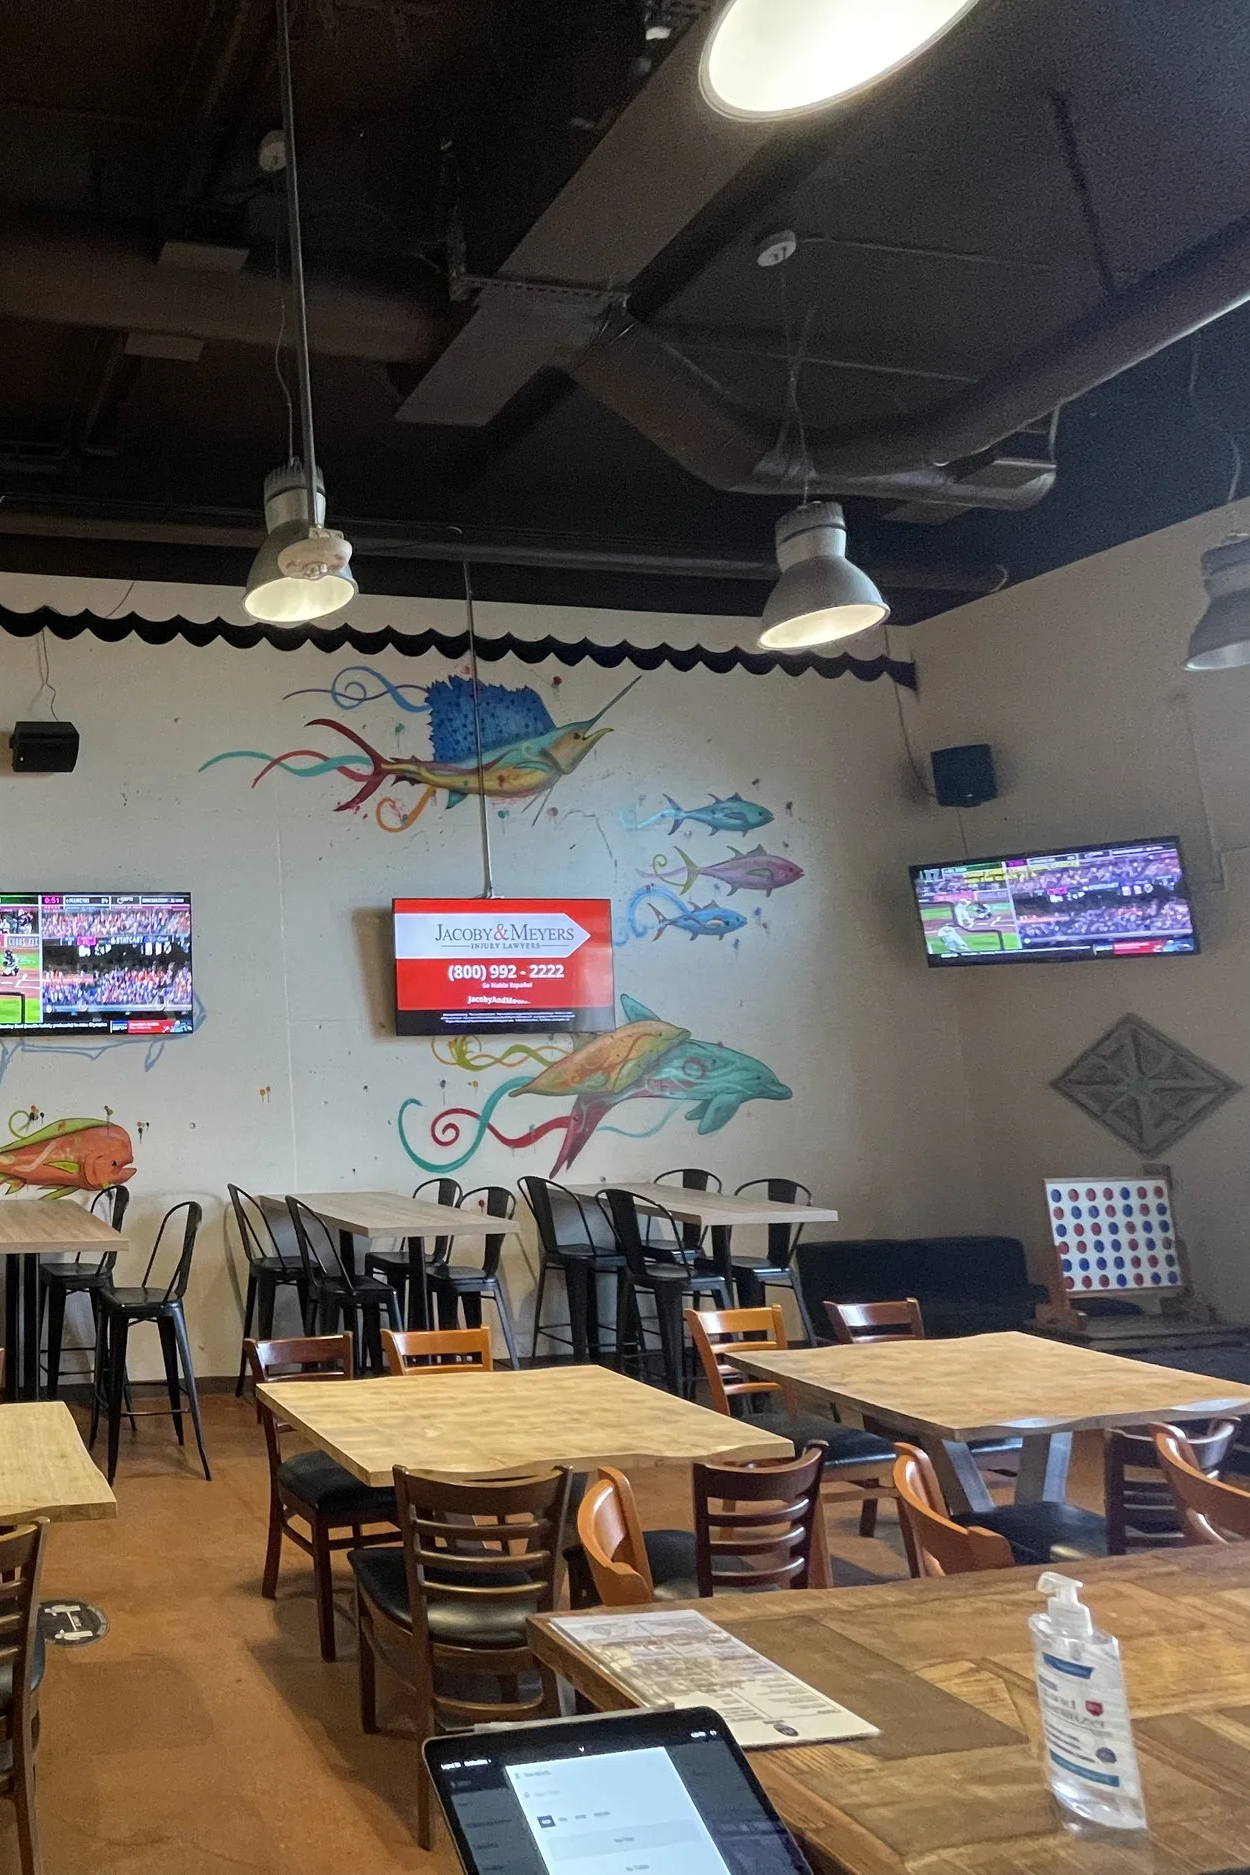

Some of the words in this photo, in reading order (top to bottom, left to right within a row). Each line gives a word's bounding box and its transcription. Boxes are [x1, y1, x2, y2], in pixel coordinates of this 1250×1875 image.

[448, 965, 487, 982] (800)
[490, 964, 518, 979] 992
[529, 964, 565, 979] 2222
